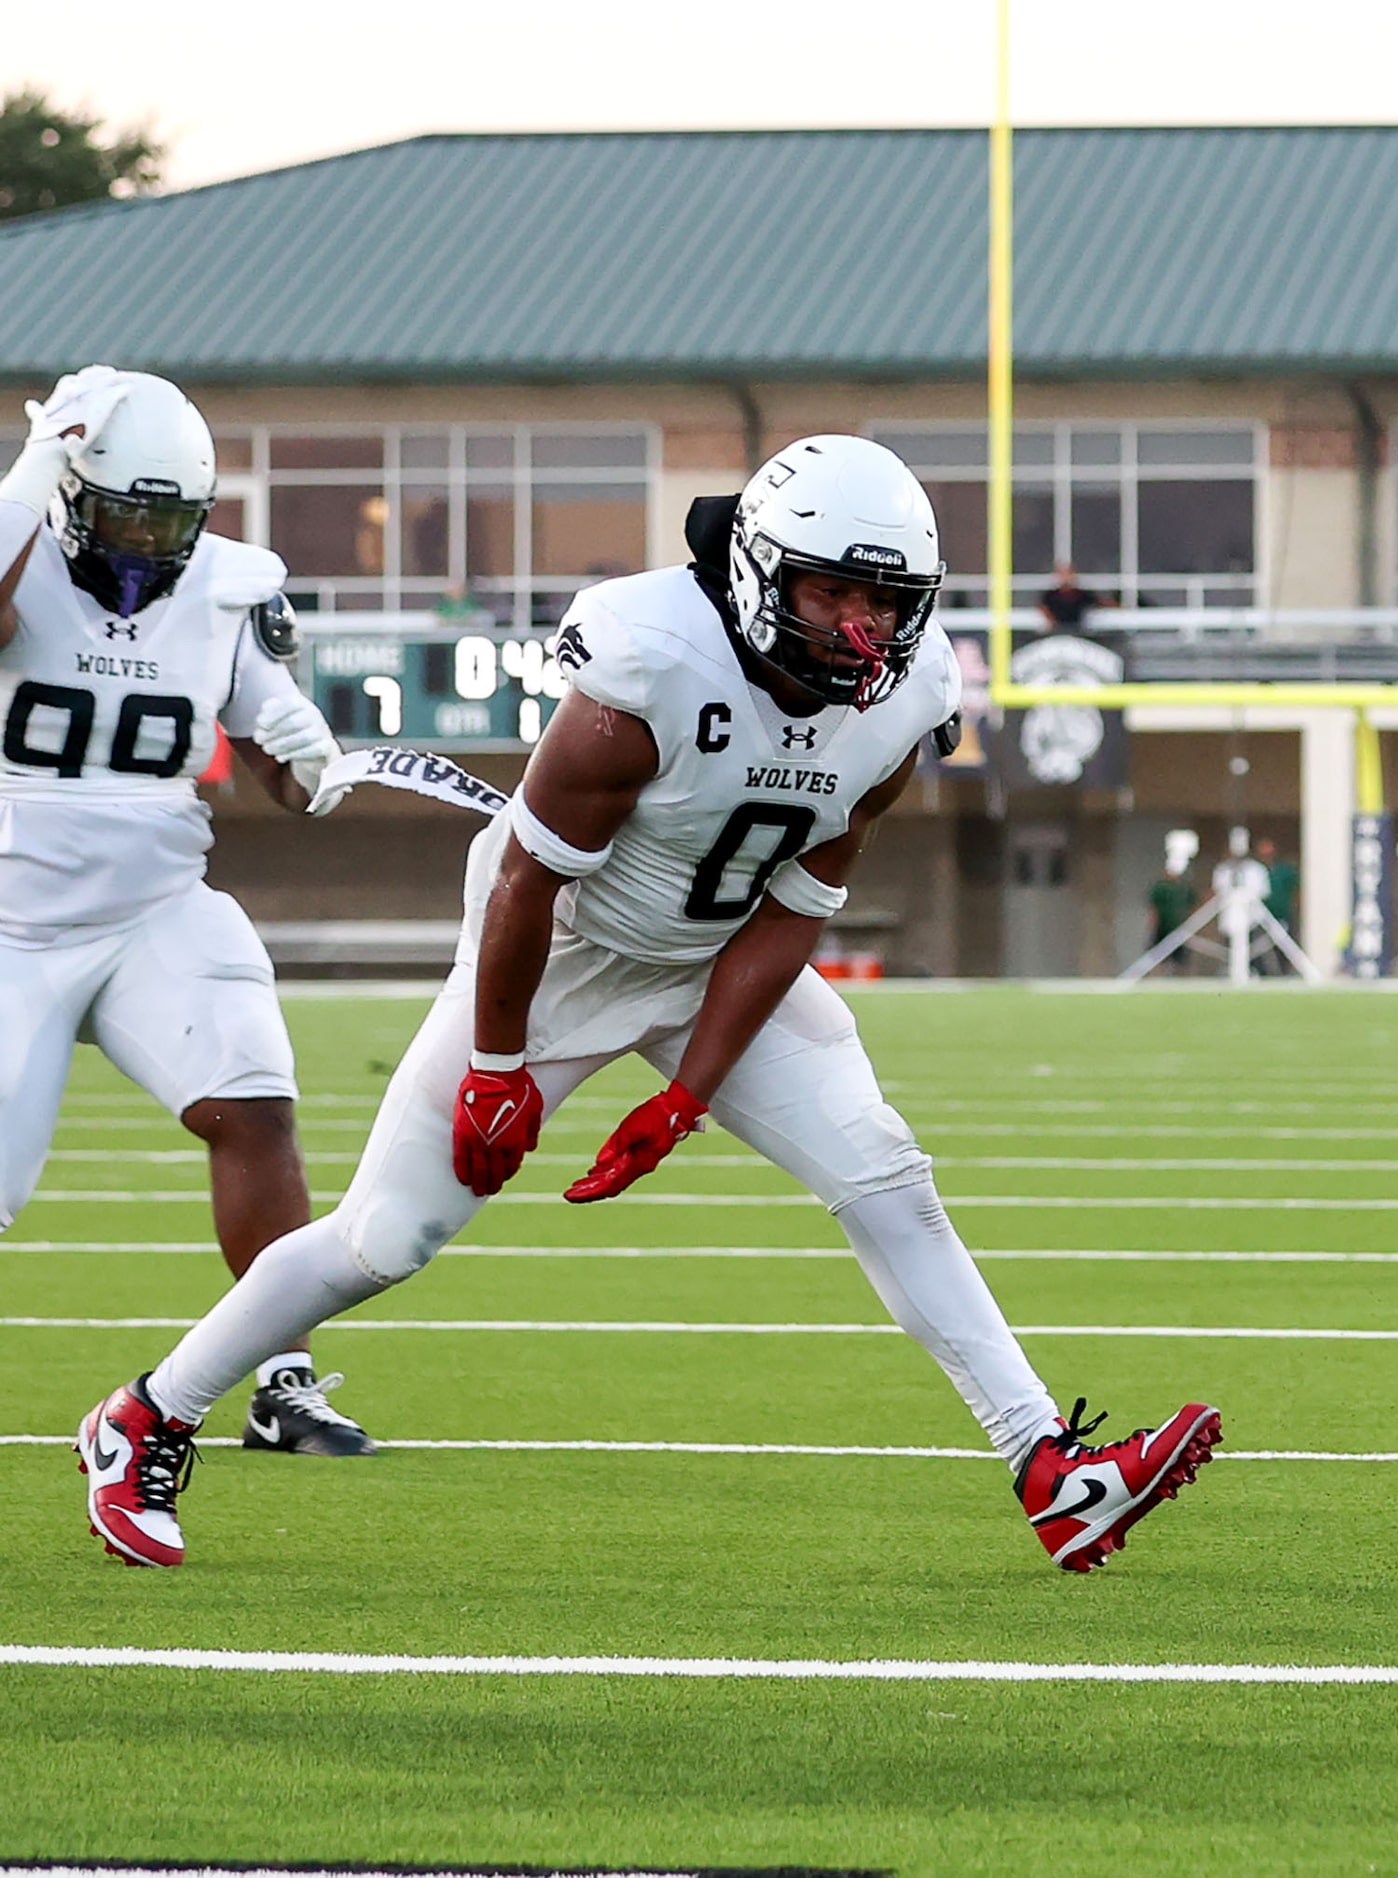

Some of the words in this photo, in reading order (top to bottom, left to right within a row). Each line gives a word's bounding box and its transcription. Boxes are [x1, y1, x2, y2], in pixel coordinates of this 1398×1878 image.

[76, 653, 160, 681] WOLVES
[362, 675, 401, 737] 7
[518, 697, 541, 743] 1
[695, 702, 732, 753] C
[744, 766, 839, 795] WOLVES
[684, 801, 817, 921] 0
